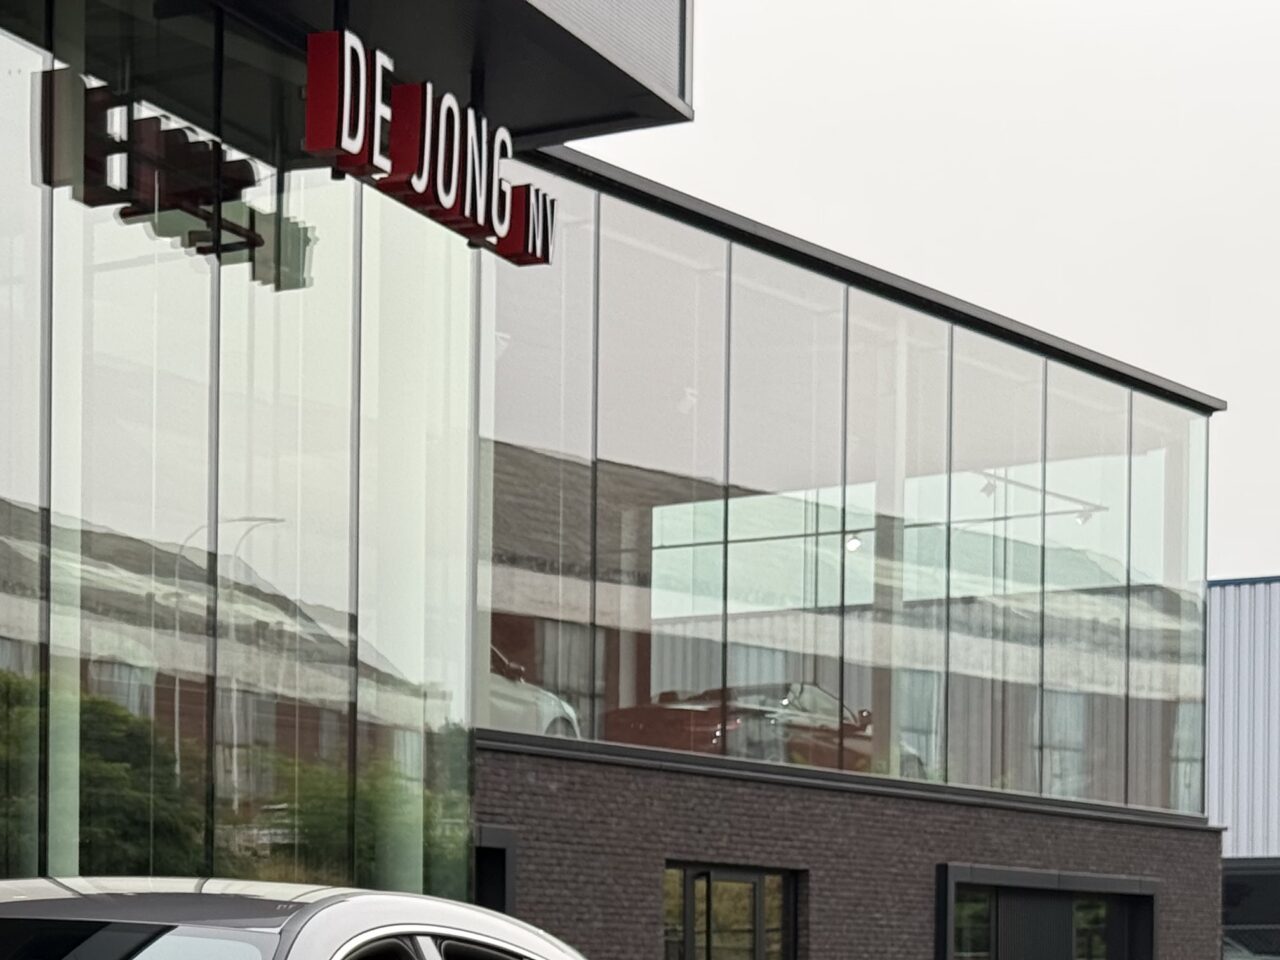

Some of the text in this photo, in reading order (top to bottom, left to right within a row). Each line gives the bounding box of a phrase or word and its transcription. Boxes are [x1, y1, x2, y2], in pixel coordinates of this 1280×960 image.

[341, 29, 557, 265] DE JONG NV
